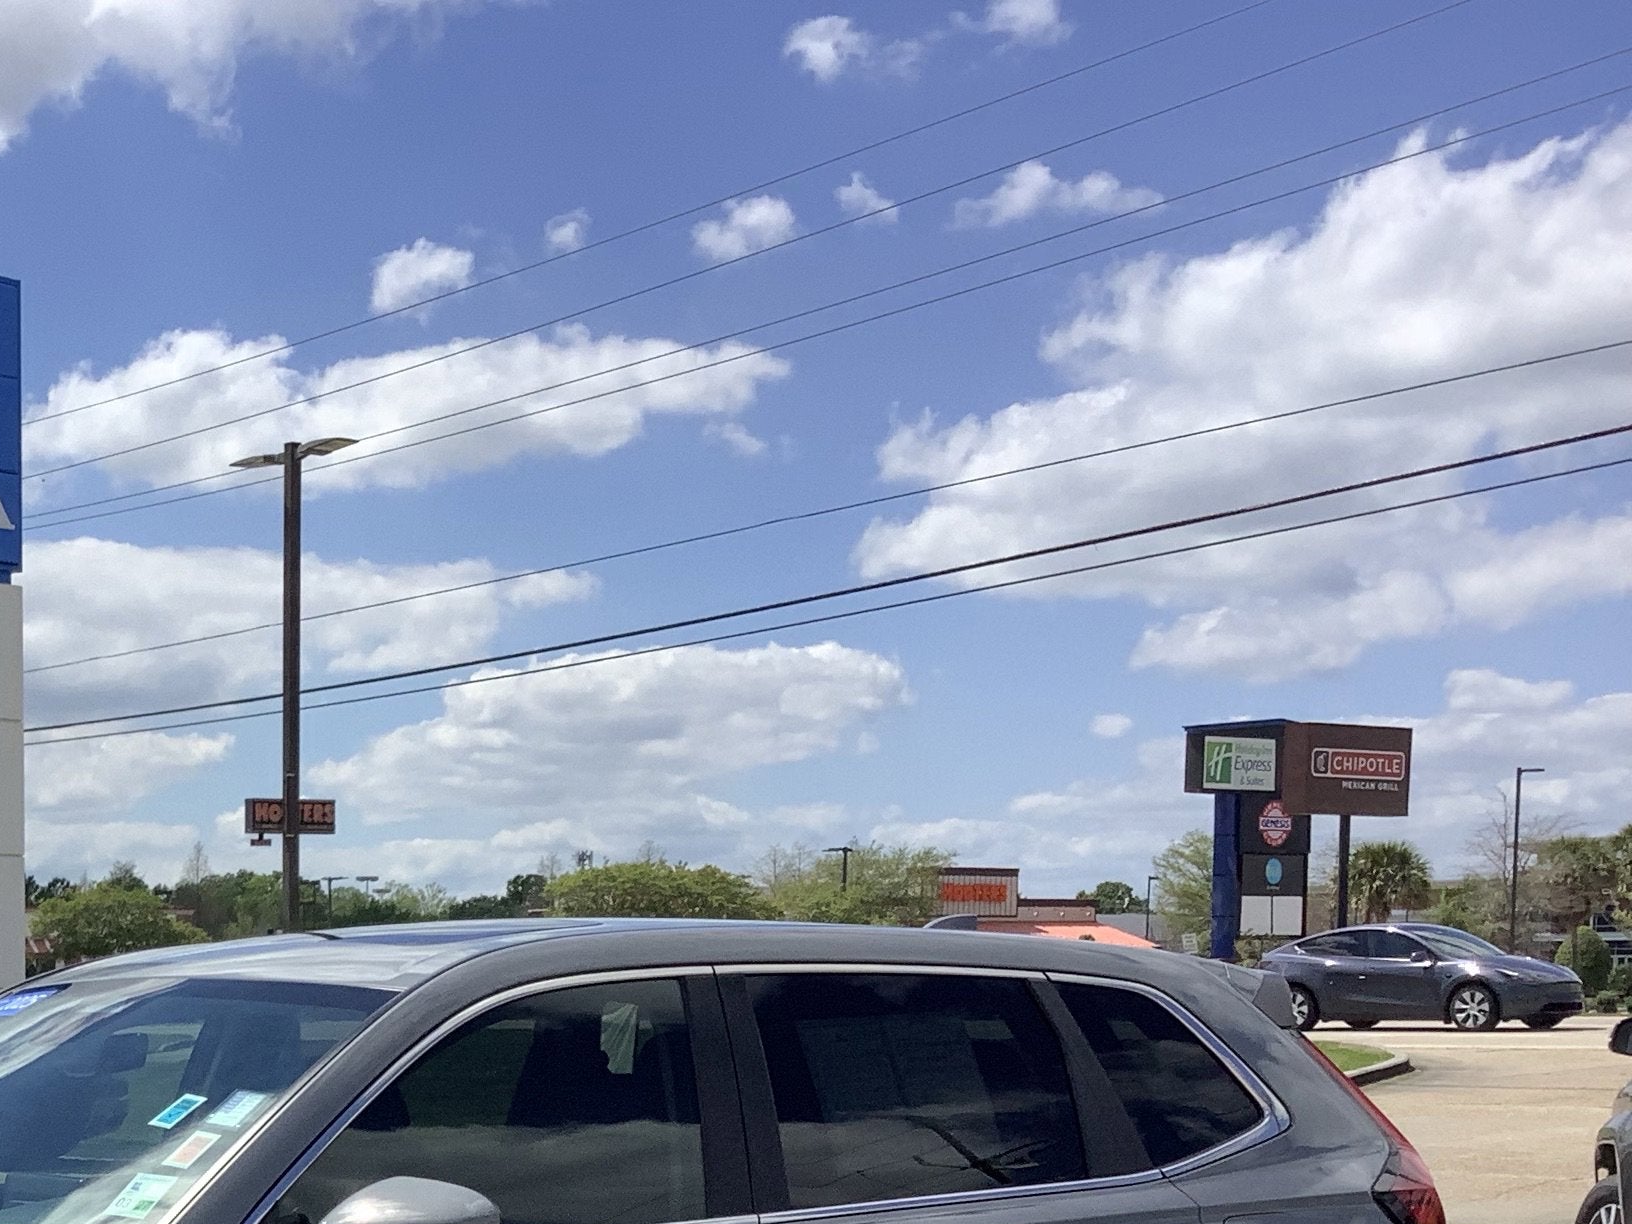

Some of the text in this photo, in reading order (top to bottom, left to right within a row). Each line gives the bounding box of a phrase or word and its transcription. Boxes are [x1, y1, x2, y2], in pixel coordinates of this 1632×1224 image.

[1234, 755, 1272, 774] Express
[1333, 756, 1401, 774] CHIPOTLE
[1377, 781, 1399, 791] GRILL
[254, 802, 333, 824] HOERS
